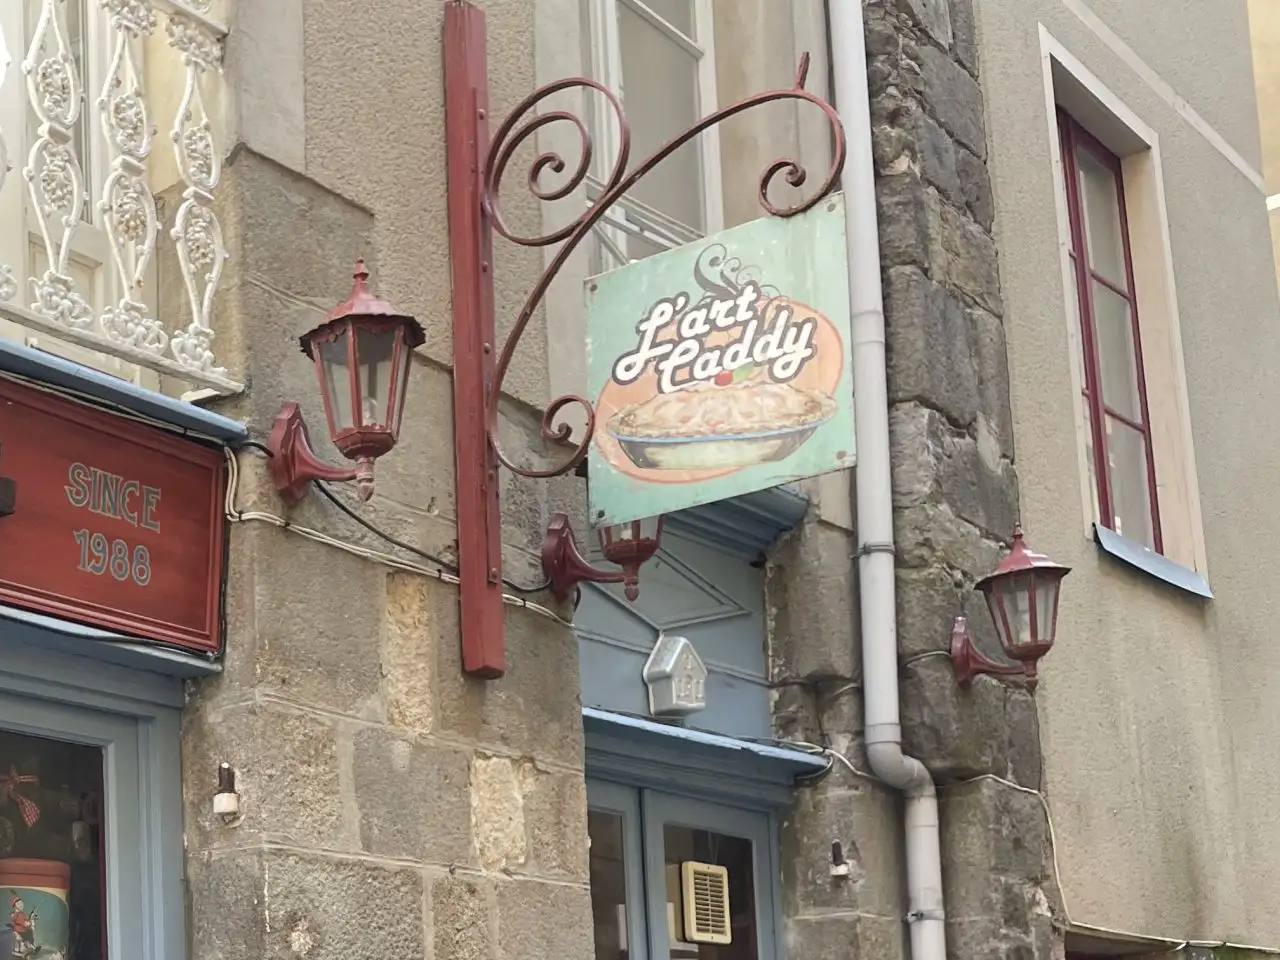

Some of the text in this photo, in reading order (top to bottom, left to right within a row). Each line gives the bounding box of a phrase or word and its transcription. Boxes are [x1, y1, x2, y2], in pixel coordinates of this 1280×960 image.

[614, 284, 758, 382] L'art
[658, 308, 814, 394] Caddy
[64, 462, 161, 534] SINCE
[73, 528, 151, 586] 1988
